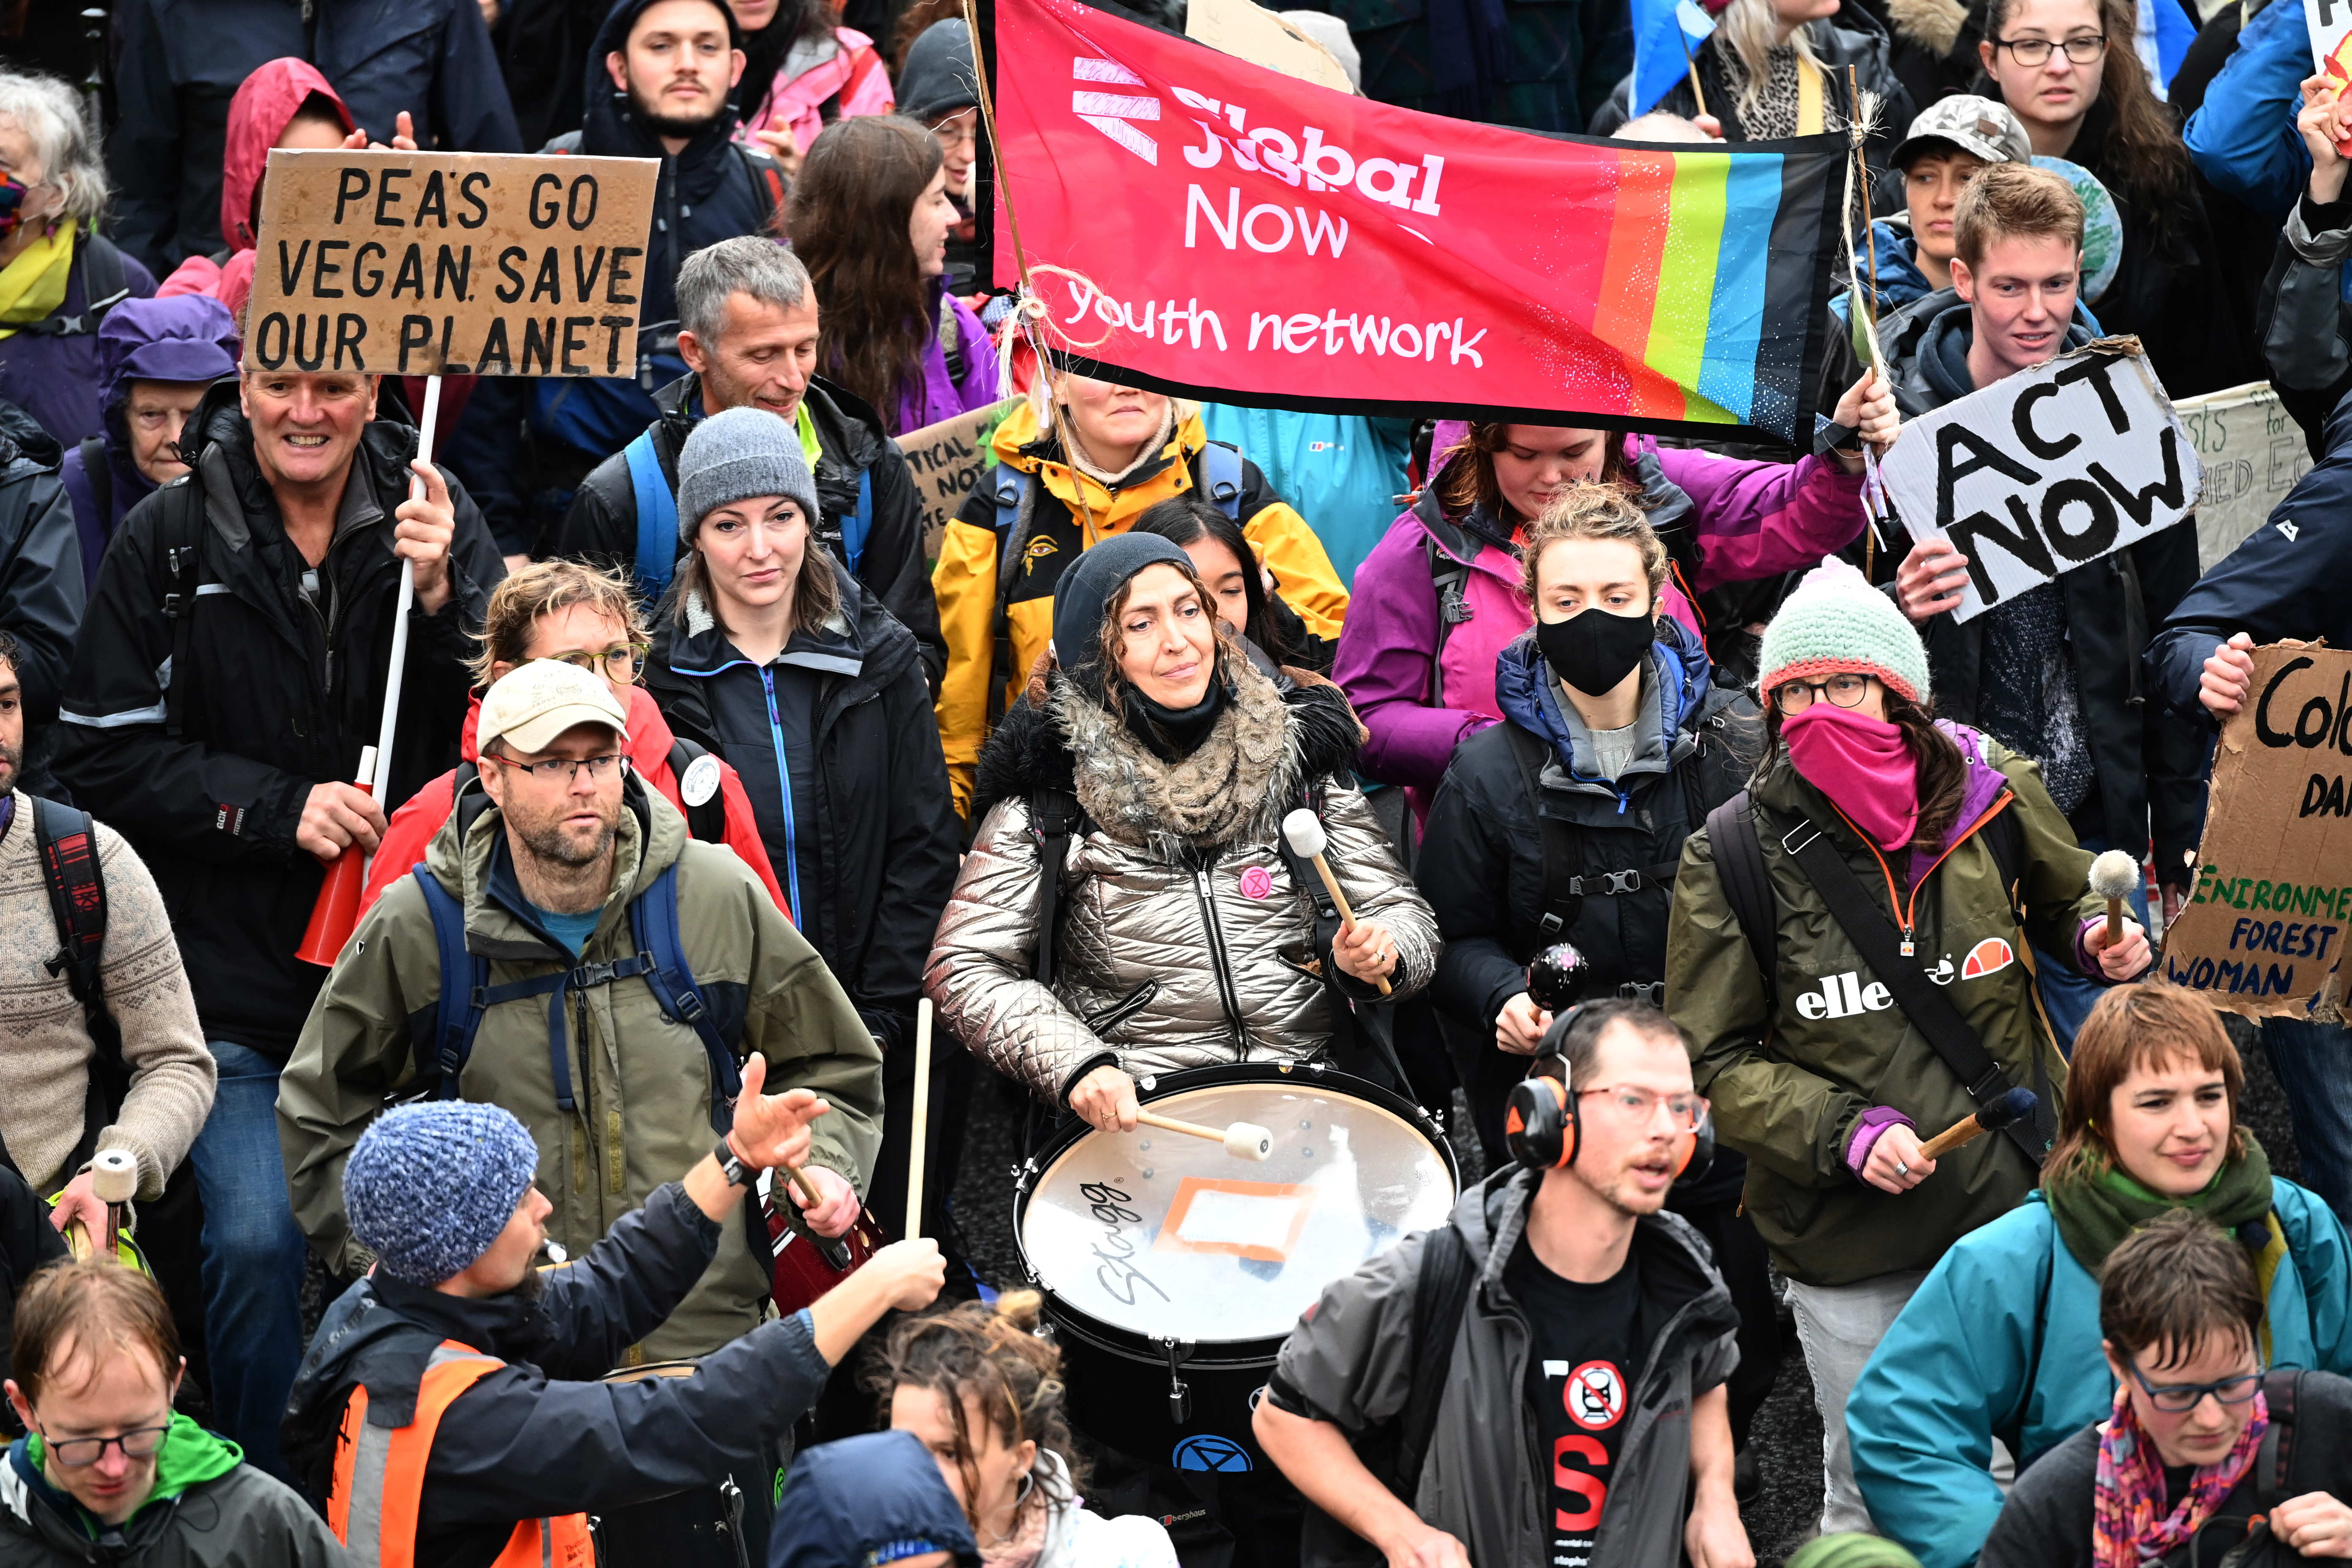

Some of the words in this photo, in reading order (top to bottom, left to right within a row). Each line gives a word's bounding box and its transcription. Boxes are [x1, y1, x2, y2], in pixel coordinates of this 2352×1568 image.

[529, 174, 598, 231] GO
[496, 246, 642, 304] SAVE
[256, 313, 367, 371] OUR
[398, 315, 633, 376] PLANET
[1065, 281, 1227, 351] youth
[1248, 308, 1487, 368] network
[1936, 354, 2130, 527] ACT
[2267, 406, 2288, 436] for
[1946, 426, 2184, 605] NOW
[2192, 864, 2352, 924] ENIRONME
[2230, 918, 2338, 960] FOREST
[2168, 956, 2293, 996] WOMAN
[1080, 1181, 1171, 1305] Stagg
[1172, 1509, 1206, 1522] berghaus
